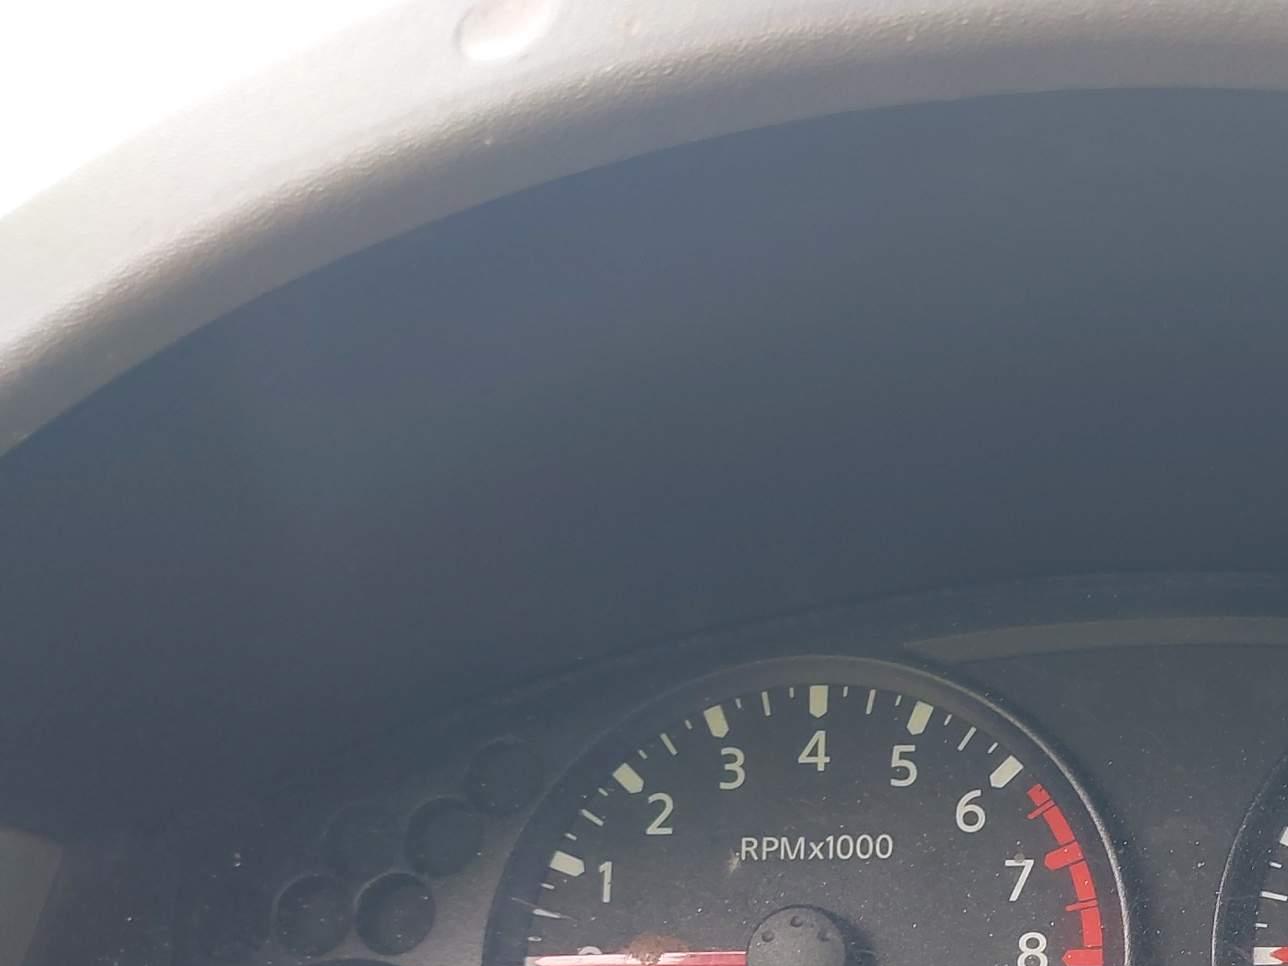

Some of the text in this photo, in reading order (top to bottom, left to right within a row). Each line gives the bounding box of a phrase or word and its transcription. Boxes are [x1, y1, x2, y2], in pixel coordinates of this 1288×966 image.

[719, 748, 746, 790] 3
[797, 730, 831, 772] 4
[890, 744, 918, 787] 5
[645, 793, 674, 835] 2
[955, 789, 986, 833] 6
[740, 834, 893, 862] RPMx1000
[598, 861, 613, 903] 1
[1004, 859, 1035, 902] 7
